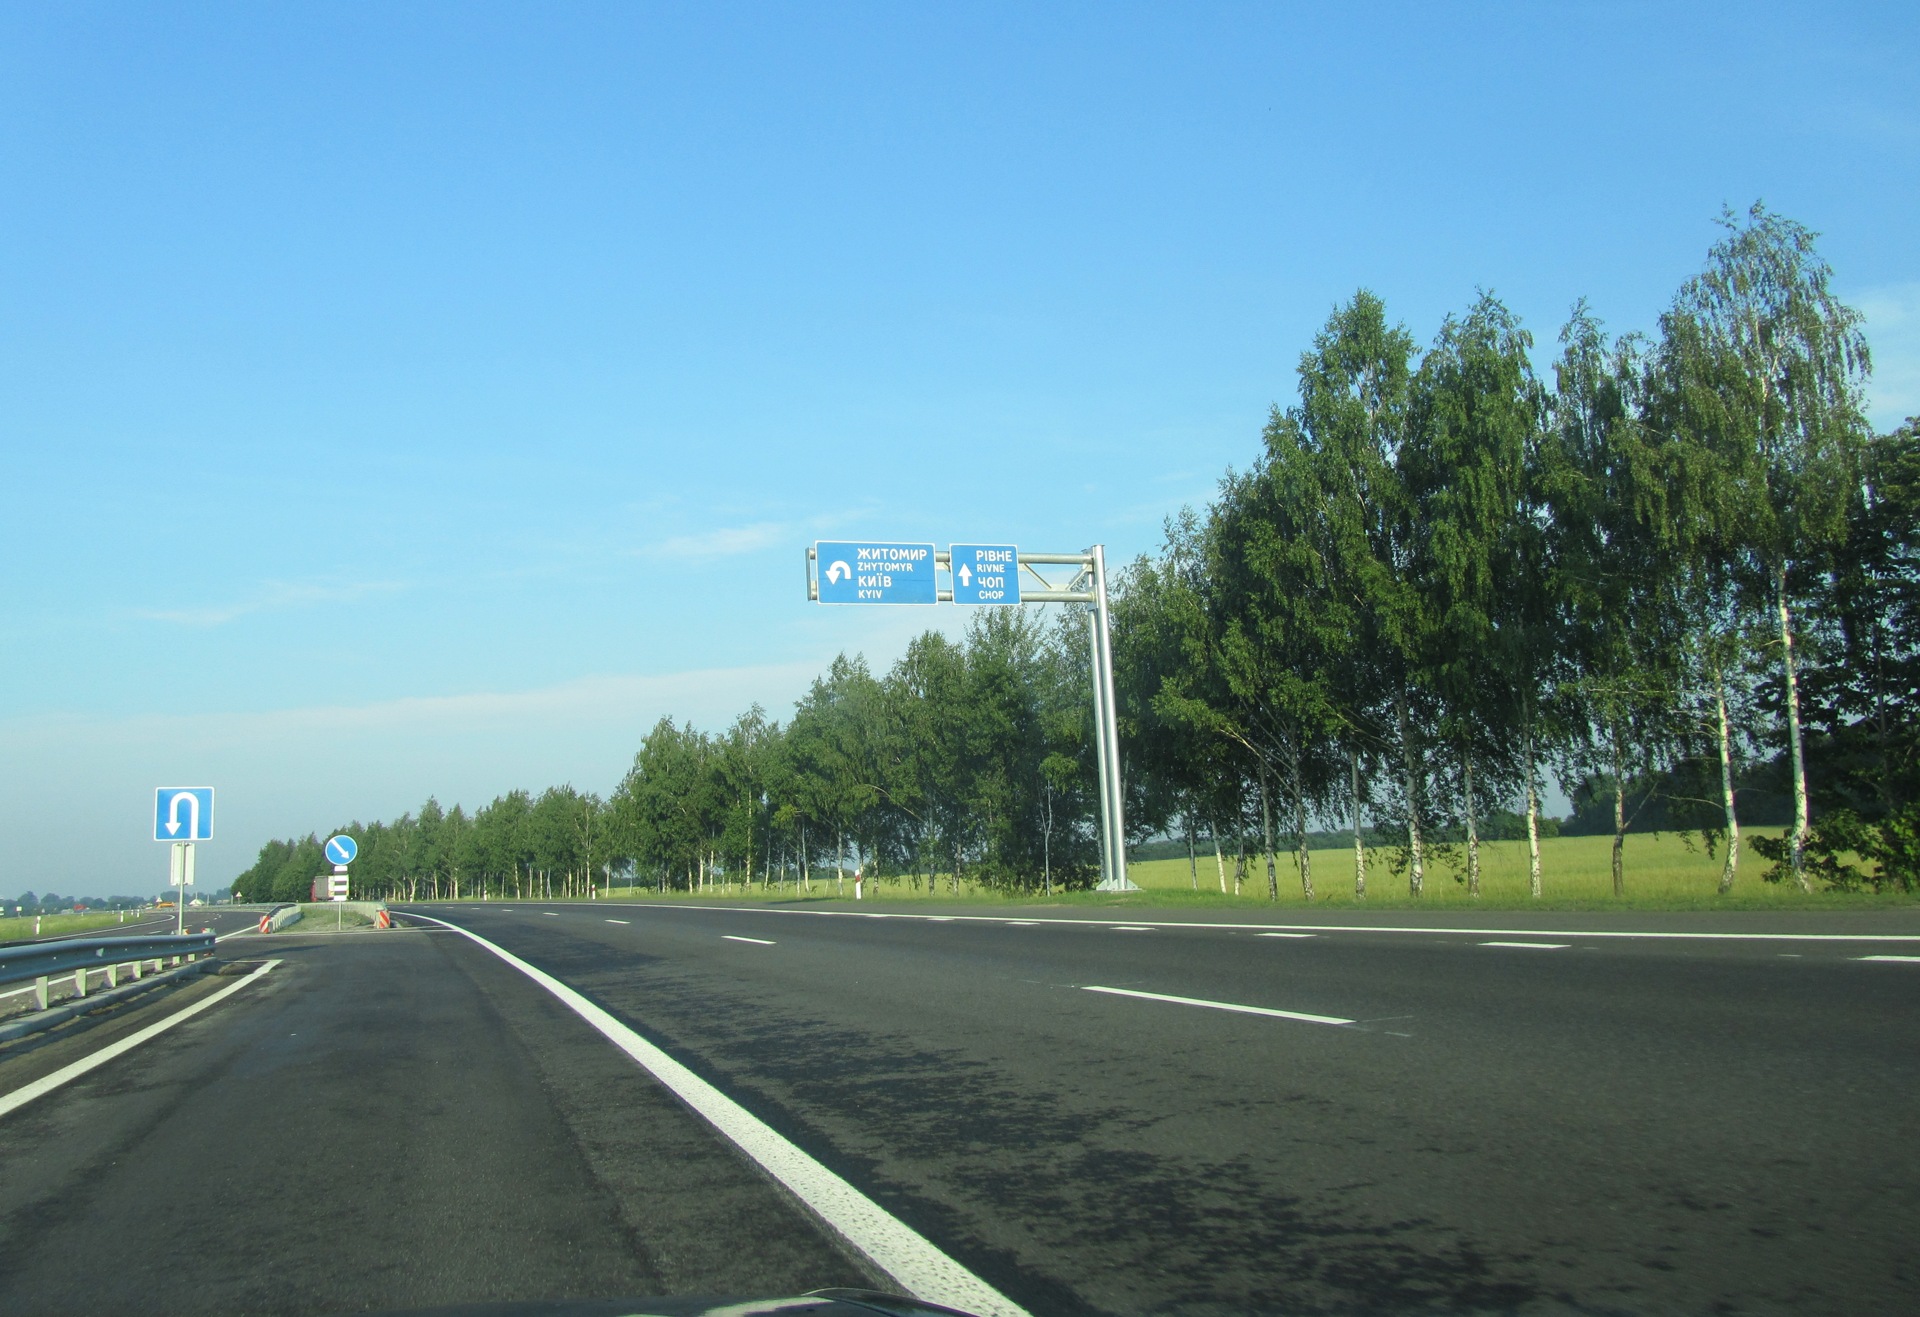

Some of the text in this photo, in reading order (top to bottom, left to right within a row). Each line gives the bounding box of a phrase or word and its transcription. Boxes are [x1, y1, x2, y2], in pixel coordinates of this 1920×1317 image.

[857, 548, 927, 561] ЖИТОМИР
[976, 550, 1013, 562] РІВНЕ
[857, 562, 913, 572] ZHYTOMYR
[976, 564, 1005, 573] RIVNE
[858, 573, 892, 587] КИЇВ
[977, 577, 1004, 588] ЧОП
[858, 590, 883, 599] KYIV
[978, 590, 1005, 600] CHOP
